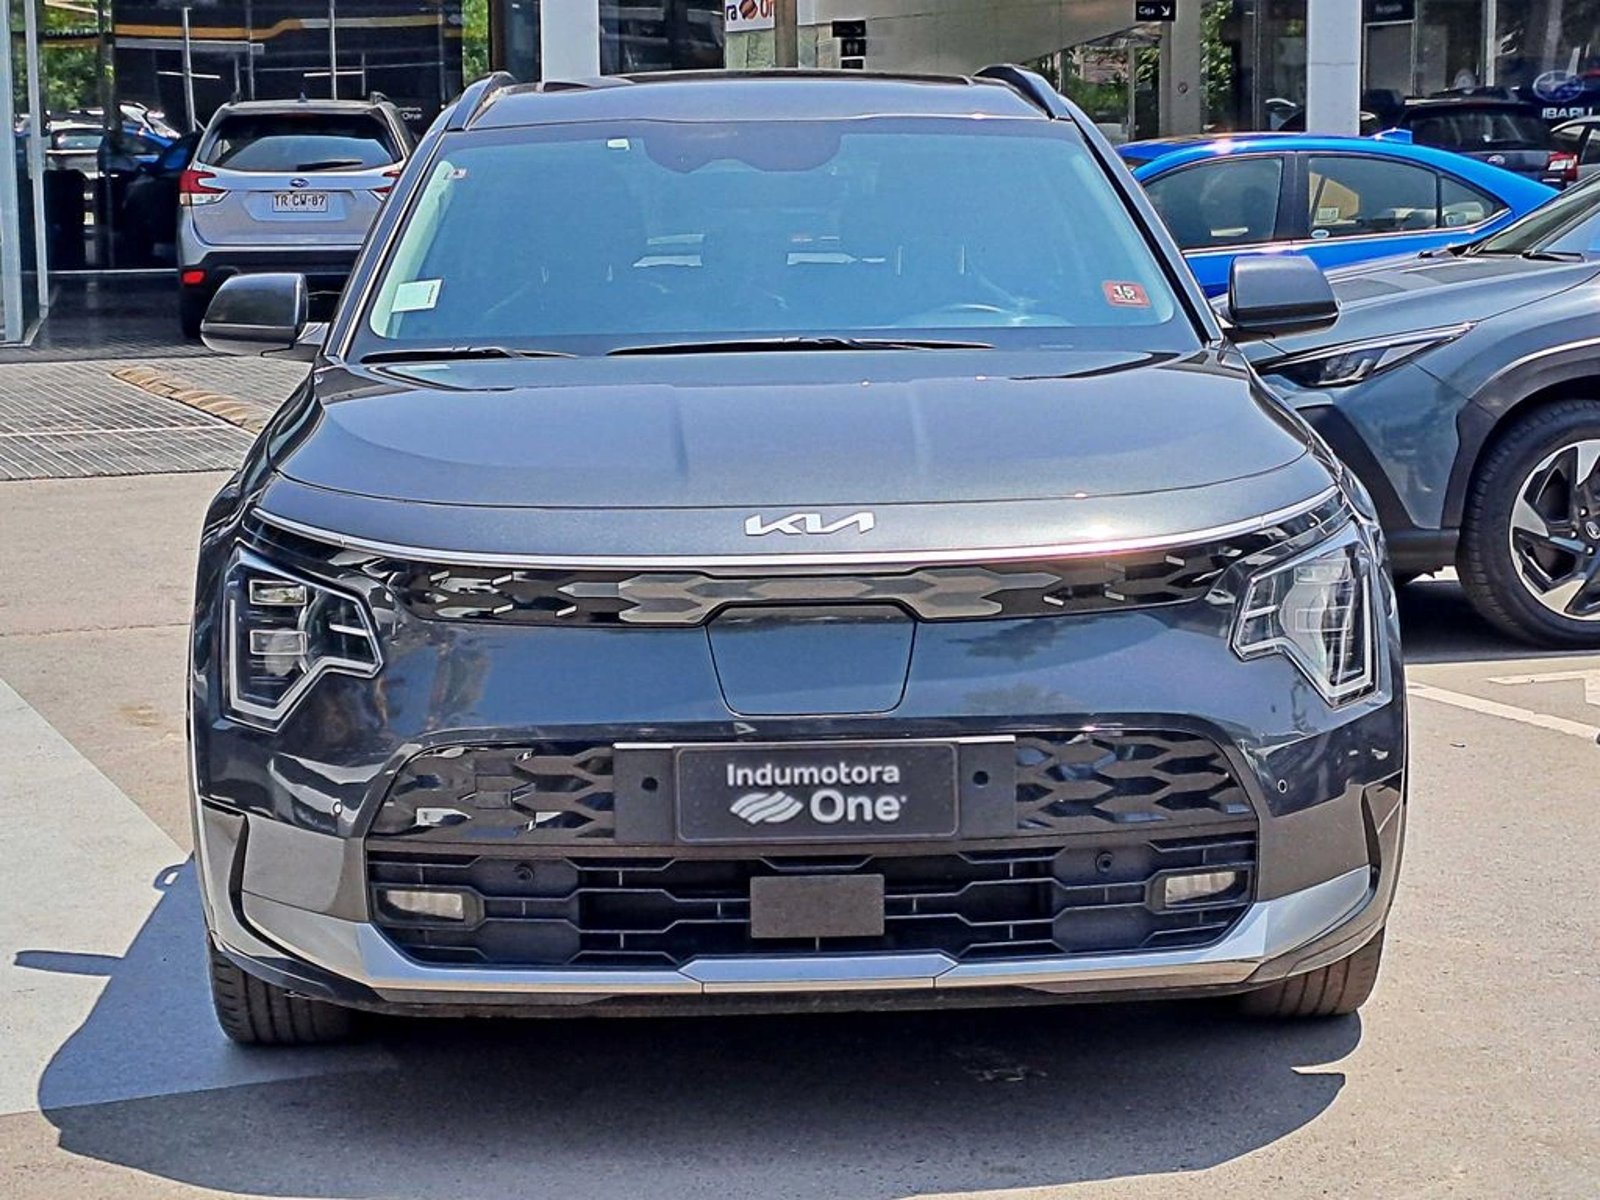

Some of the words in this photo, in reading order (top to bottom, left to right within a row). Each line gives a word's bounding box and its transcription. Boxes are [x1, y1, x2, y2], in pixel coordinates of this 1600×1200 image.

[1542, 107, 1593, 119] BARU
[744, 511, 875, 536] KIA
[727, 763, 900, 786] Indumotora
[810, 788, 901, 823] One
